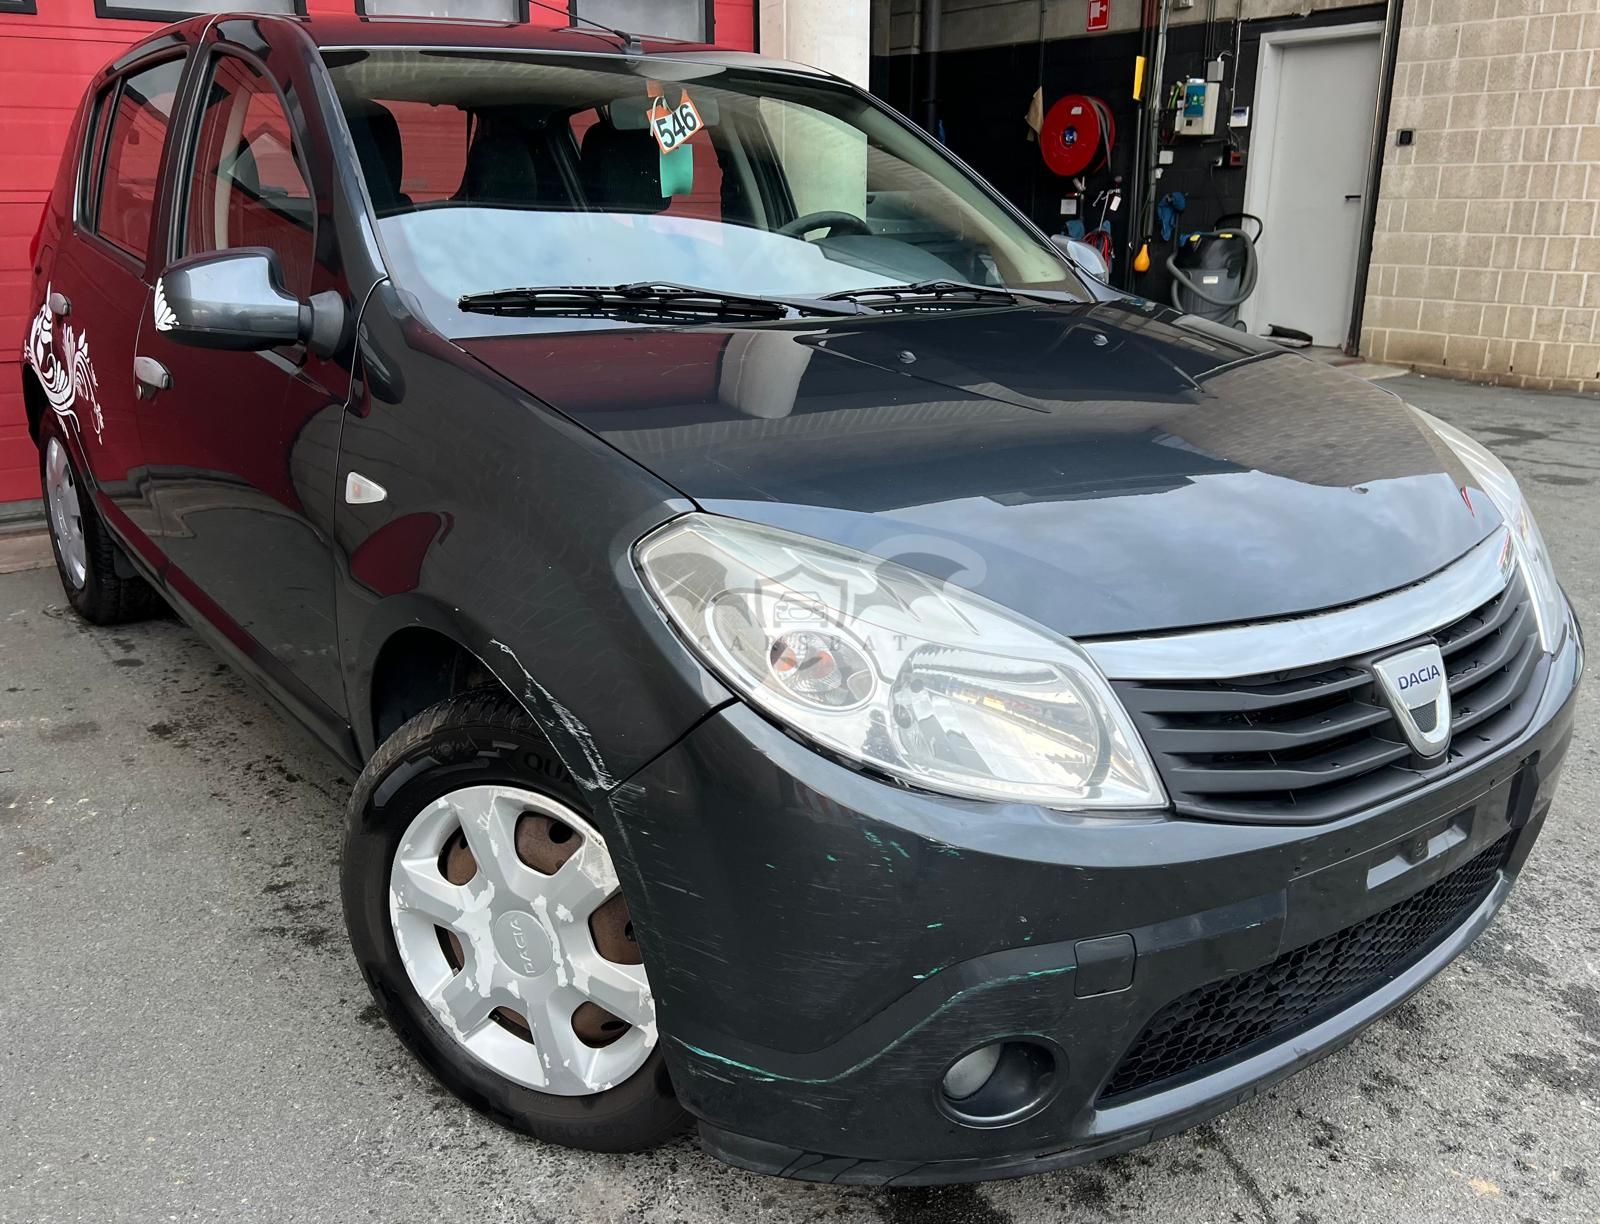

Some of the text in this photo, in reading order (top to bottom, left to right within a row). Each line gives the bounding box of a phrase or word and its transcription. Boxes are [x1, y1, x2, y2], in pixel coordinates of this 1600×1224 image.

[655, 104, 698, 148] 546
[1398, 665, 1440, 690] DACIA
[510, 919, 536, 974] DACIA
